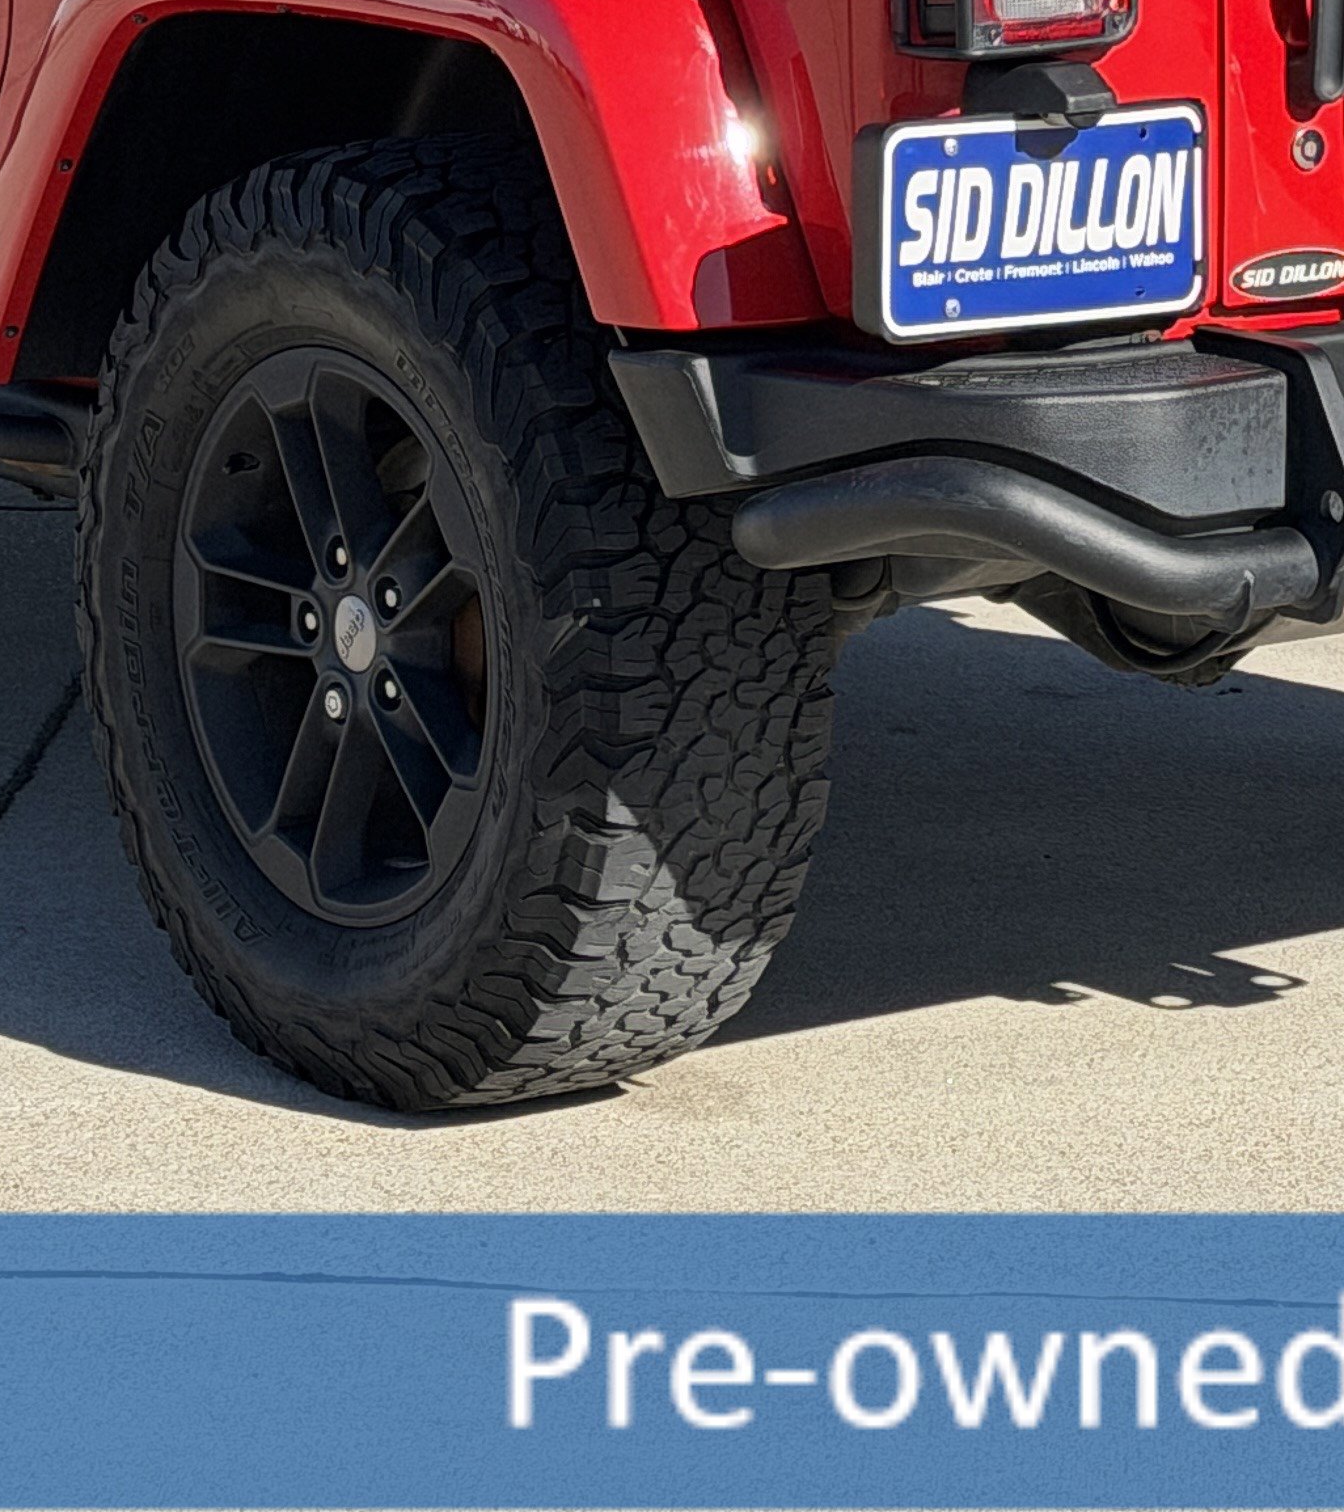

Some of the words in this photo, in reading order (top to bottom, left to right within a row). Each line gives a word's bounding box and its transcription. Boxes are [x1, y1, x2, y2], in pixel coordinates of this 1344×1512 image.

[899, 166, 994, 267] SID
[1000, 149, 1189, 260] DILLON
[911, 270, 946, 288] Blair
[954, 266, 993, 284] Crete
[1004, 260, 1063, 282] Fremont
[1071, 255, 1121, 275] Lincoln
[1128, 250, 1175, 268] Wahoo
[1240, 267, 1276, 289] SID
[123, 407, 169, 524] T/A
